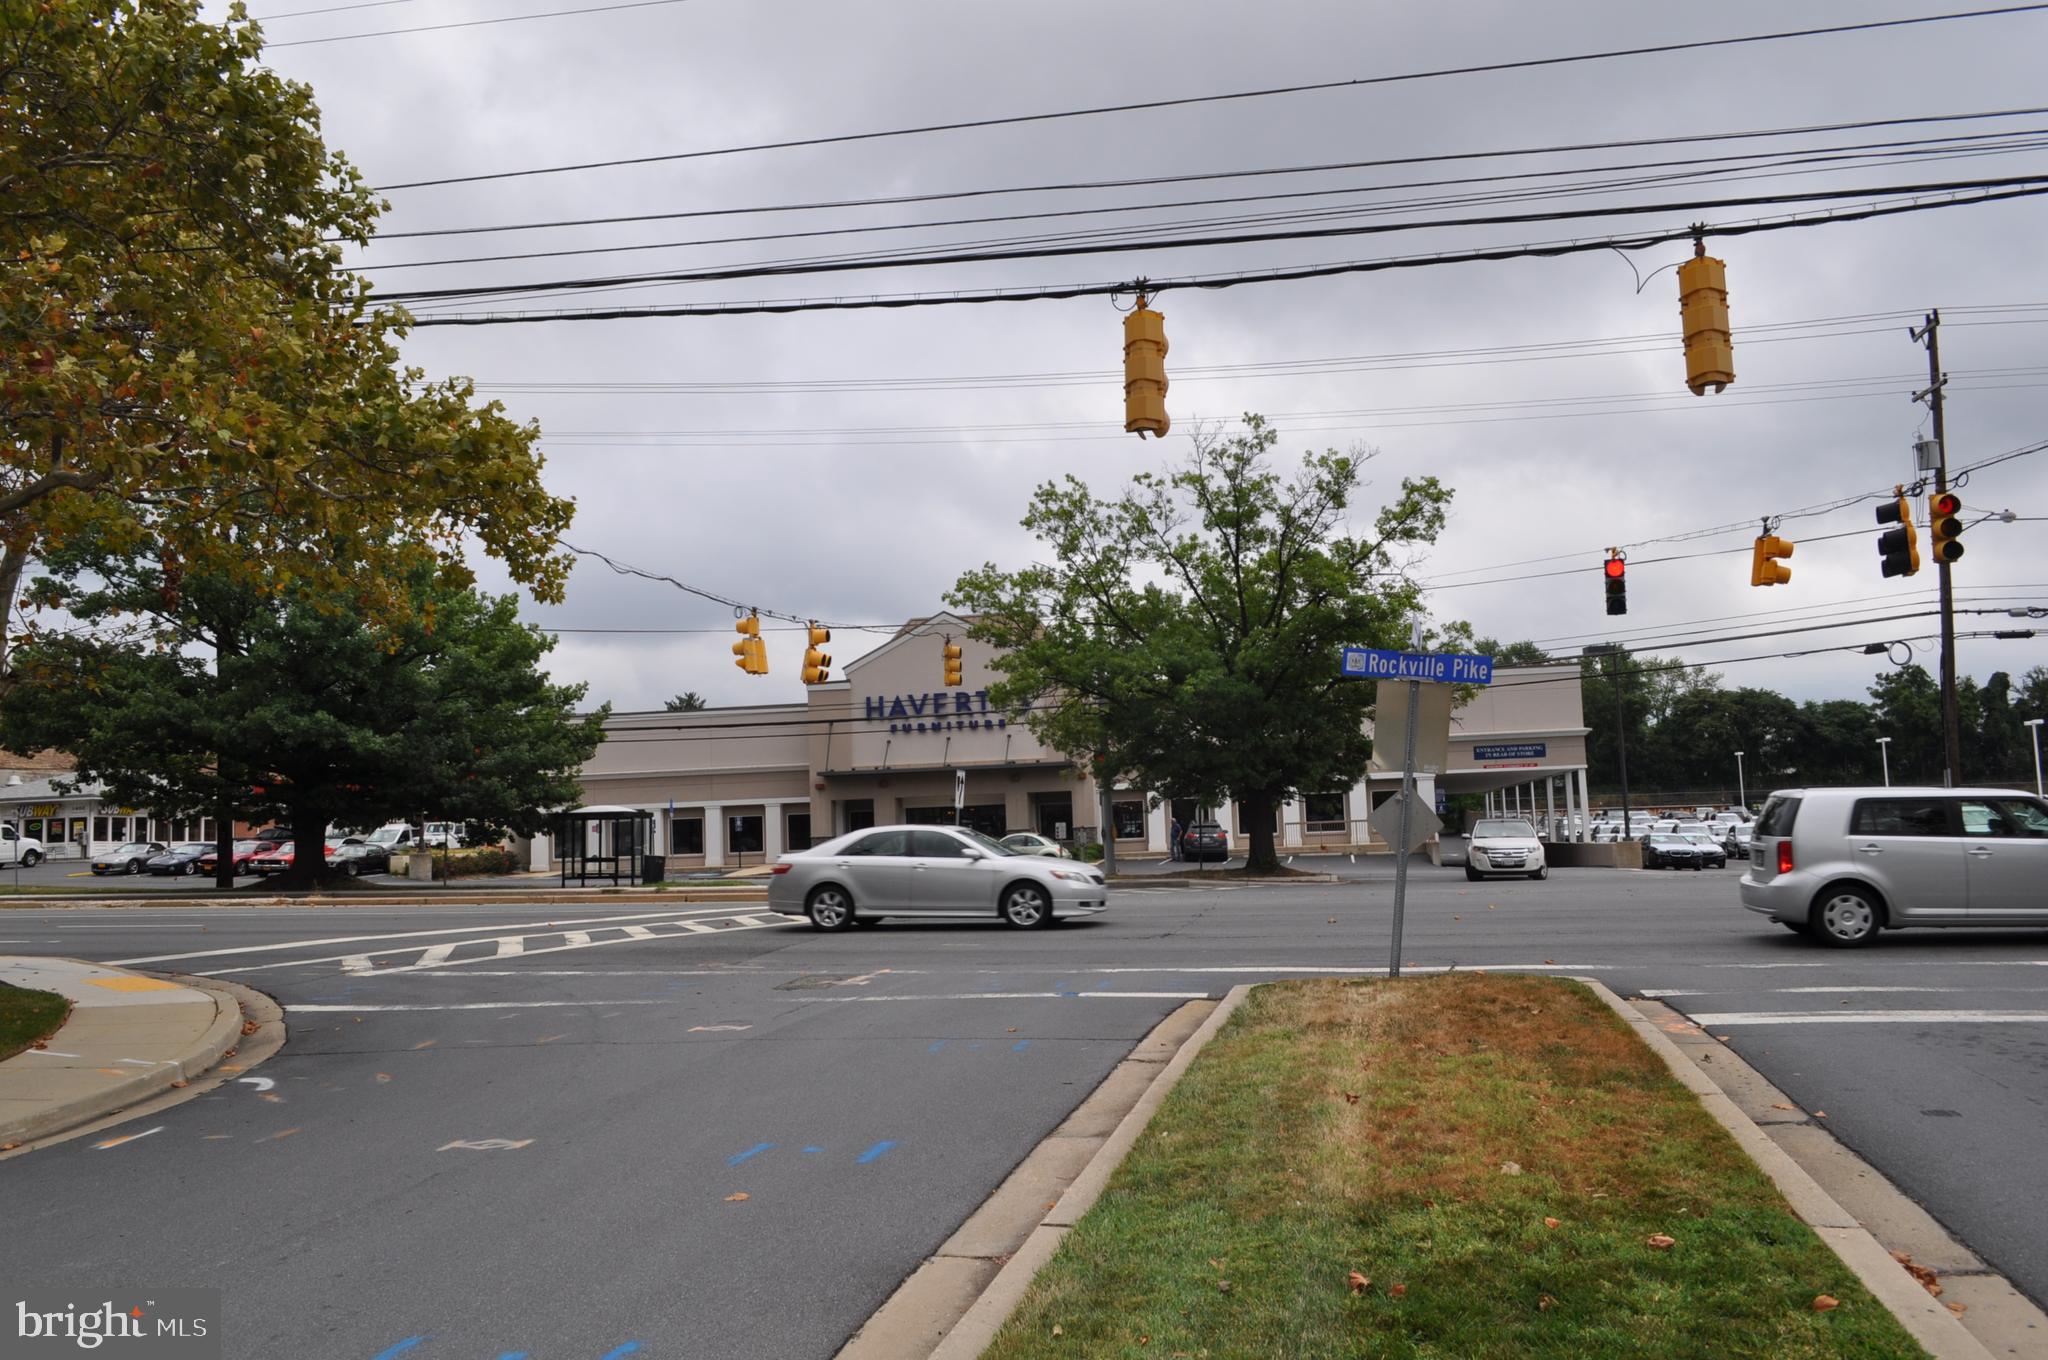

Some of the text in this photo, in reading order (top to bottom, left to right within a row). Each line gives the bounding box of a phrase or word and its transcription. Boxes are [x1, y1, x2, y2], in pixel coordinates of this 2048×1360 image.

[1368, 653, 1488, 679] Rockville Pike
[866, 691, 1031, 721] HAVERT
[100, 804, 132, 815] SUBW
